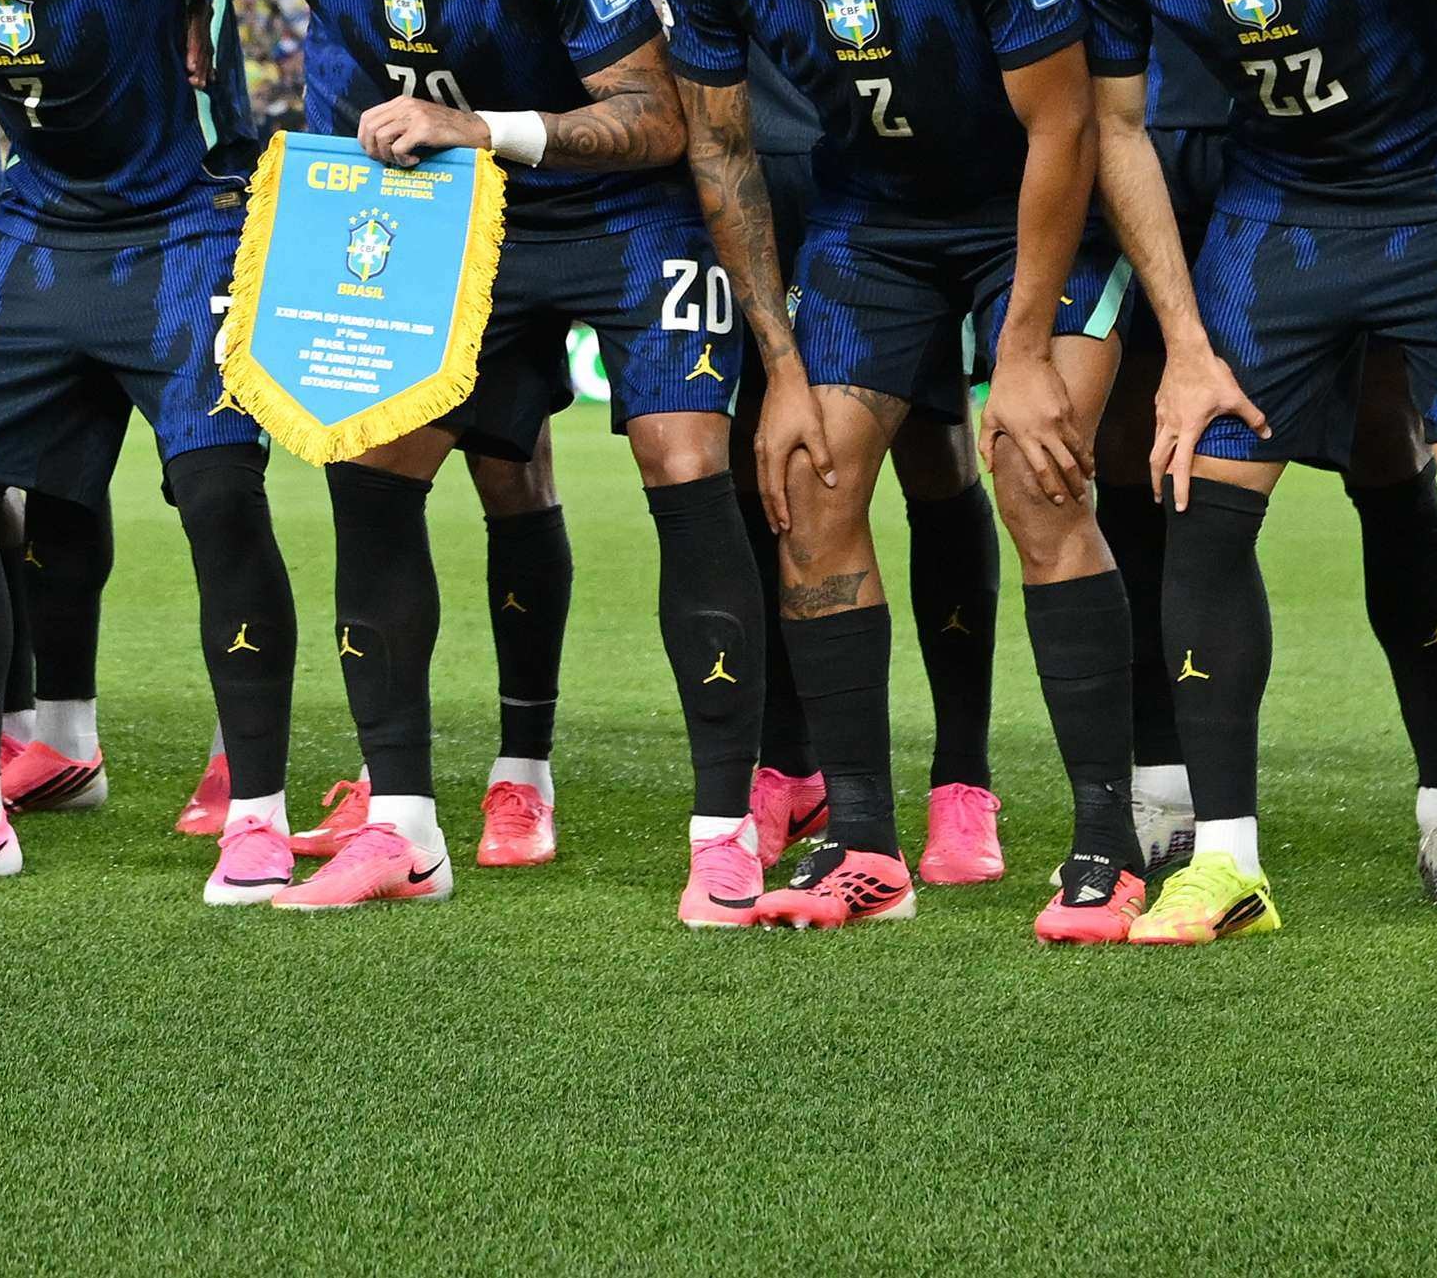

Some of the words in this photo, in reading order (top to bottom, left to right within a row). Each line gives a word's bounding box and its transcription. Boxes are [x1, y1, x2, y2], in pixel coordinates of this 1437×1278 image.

[1237, 23, 1299, 45] BRASIL
[389, 38, 438, 54] BRASIL
[835, 46, 892, 61] BRASIL
[1241, 47, 1349, 117] 22
[8, 77, 43, 128] 7
[855, 77, 914, 137] 2
[307, 161, 371, 193] CBF
[381, 177, 433, 190] BRASILEIRA
[382, 168, 453, 183] CONFEDERAÇÃO
[394, 188, 435, 200] FUTEBOL
[337, 283, 385, 299] BRASIL
[662, 258, 733, 335] 20
[298, 309, 323, 322] COPA
[339, 315, 374, 328] MUNDO
[390, 320, 411, 332] FIFA
[312, 338, 345, 351] BRASIL
[358, 343, 386, 355] HAITI
[324, 352, 356, 365] JUNHO
[309, 364, 376, 380] PHILADELPHIA
[300, 375, 343, 390] ESTADOS
[344, 381, 380, 394] UNIDOS
